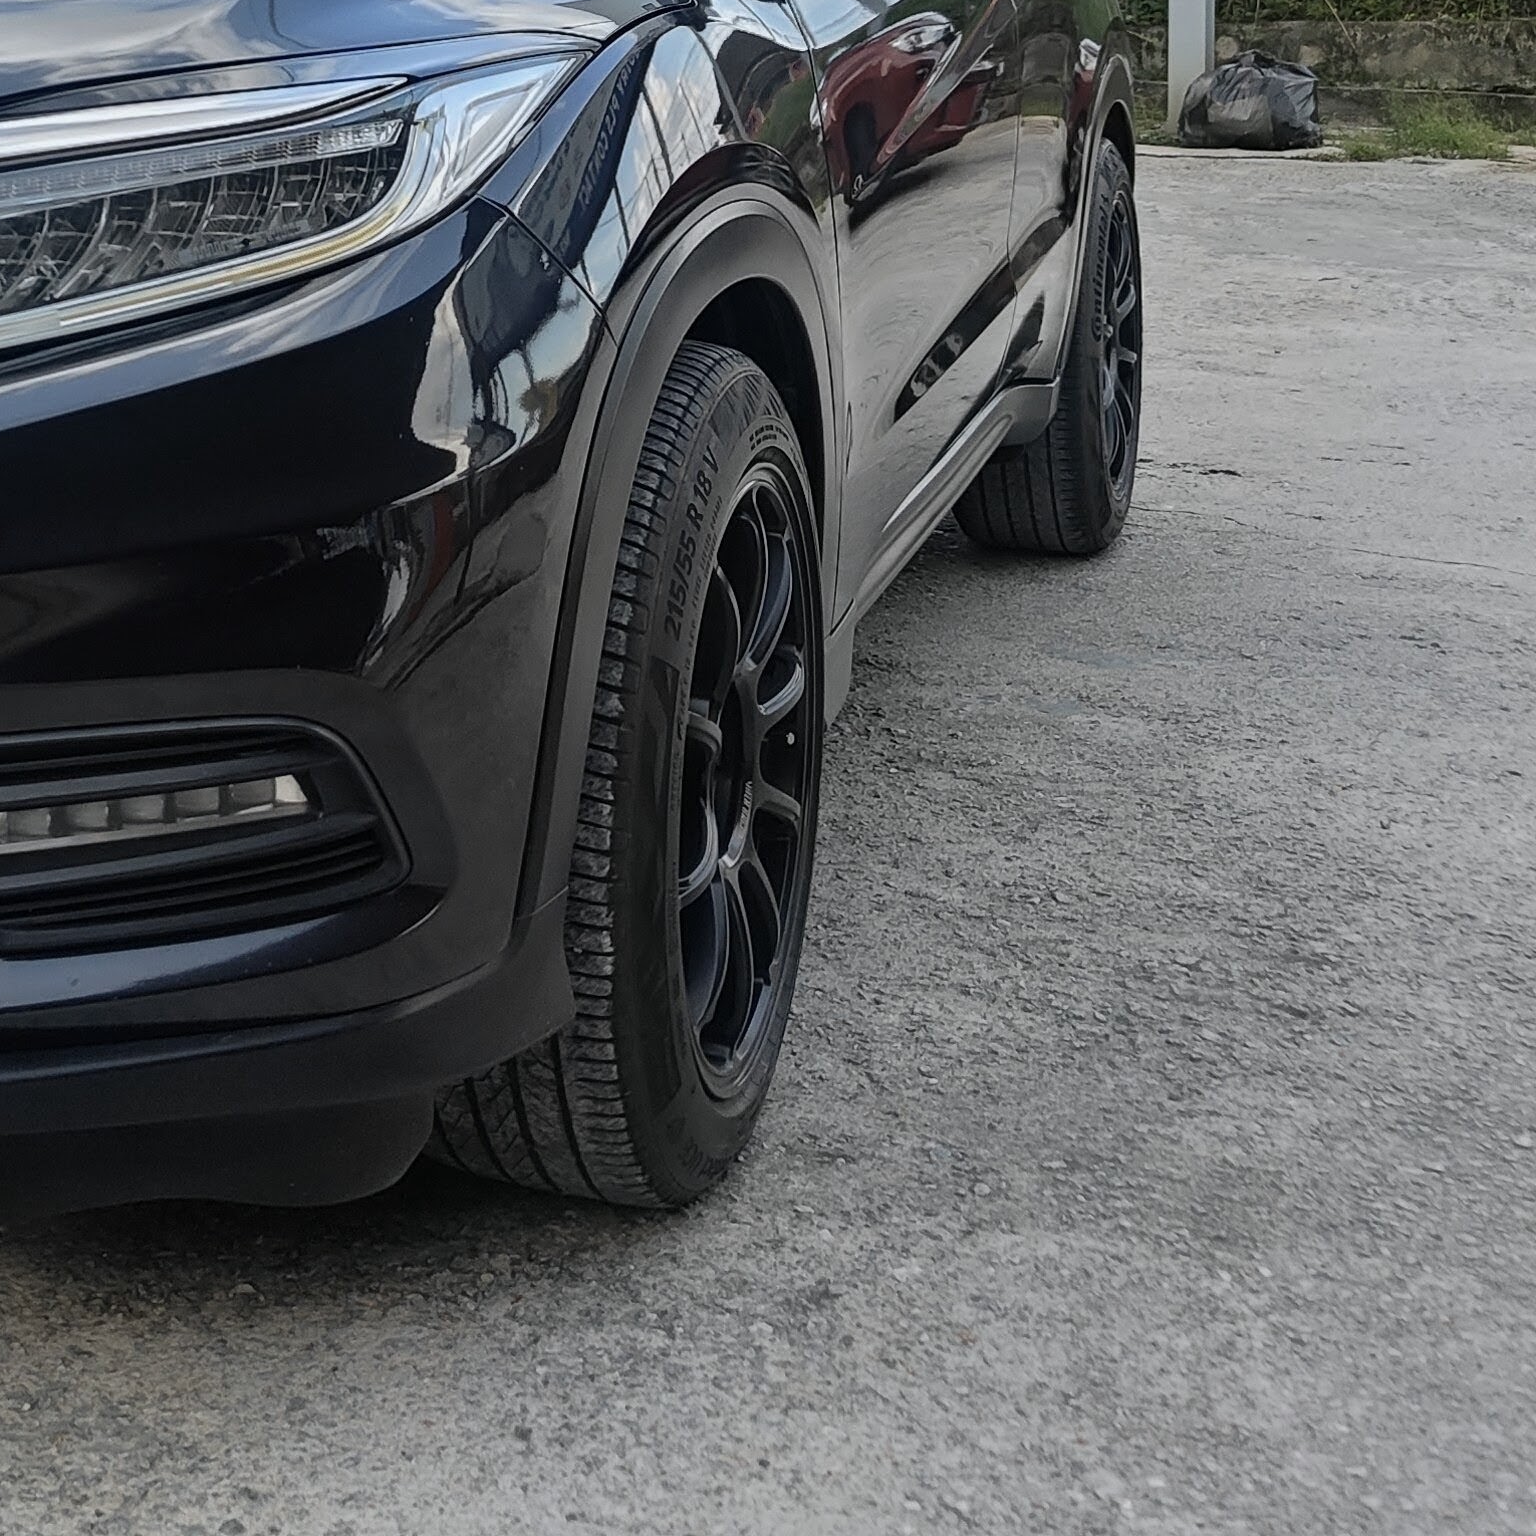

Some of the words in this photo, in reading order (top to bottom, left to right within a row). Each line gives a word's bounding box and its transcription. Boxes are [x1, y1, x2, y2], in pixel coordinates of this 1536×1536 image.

[702, 445, 719, 474] V
[694, 470, 712, 506] 18
[687, 503, 704, 531] R
[665, 530, 696, 641] 215/55
